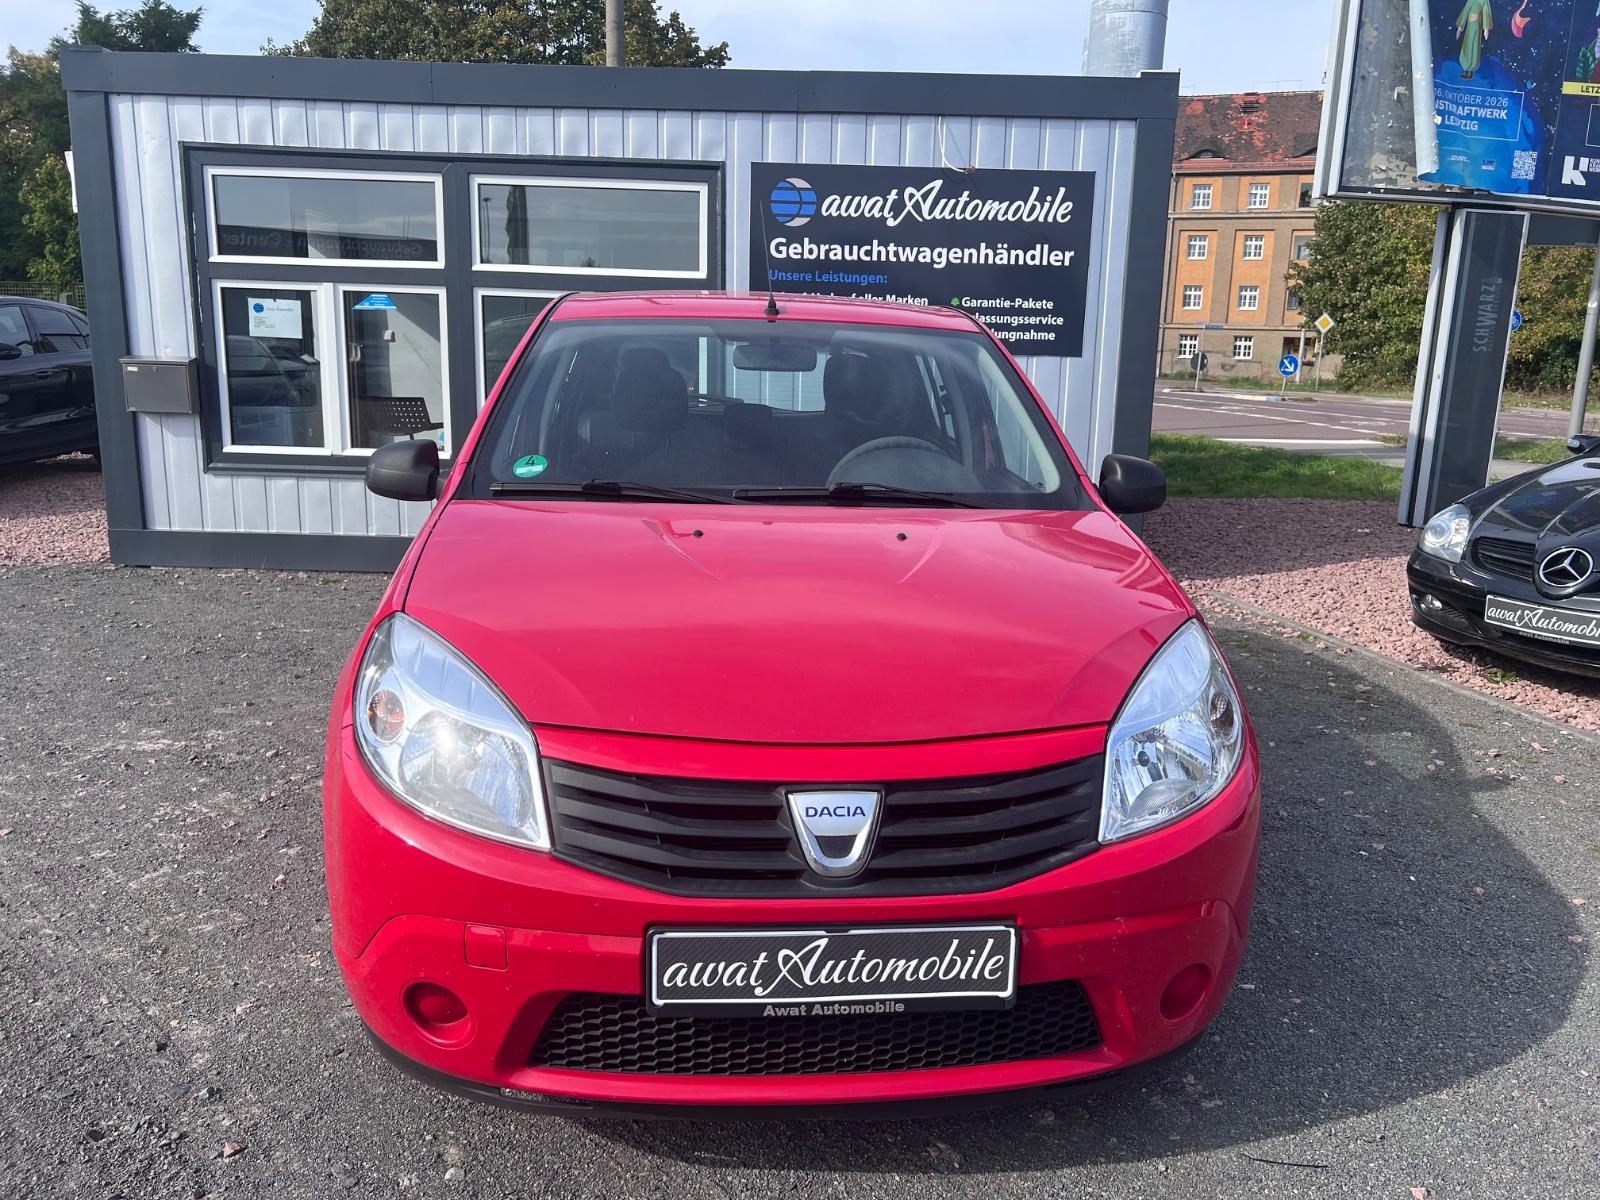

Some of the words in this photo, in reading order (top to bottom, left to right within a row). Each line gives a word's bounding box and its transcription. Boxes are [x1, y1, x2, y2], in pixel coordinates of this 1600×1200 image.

[1484, 97, 1508, 107] 2026
[821, 187, 898, 217] awat
[886, 179, 1074, 227] Automobile
[769, 237, 1075, 269] Gebrauchtwagenhändler
[768, 269, 813, 282] Unsere
[815, 271, 888, 286] Leistungen:
[886, 294, 928, 305] Marken
[961, 297, 1054, 309] Garantie-Pakete
[973, 313, 1064, 326] lassungsservice
[1472, 285, 1498, 352] SCHWARZ
[526, 455, 535, 466] 4
[1487, 607, 1522, 623] awat
[805, 805, 867, 819] DACIA
[663, 952, 769, 988] awat
[754, 937, 1005, 997] Automobile
[763, 1004, 806, 1017] Awat
[811, 1000, 905, 1016] Automobile
